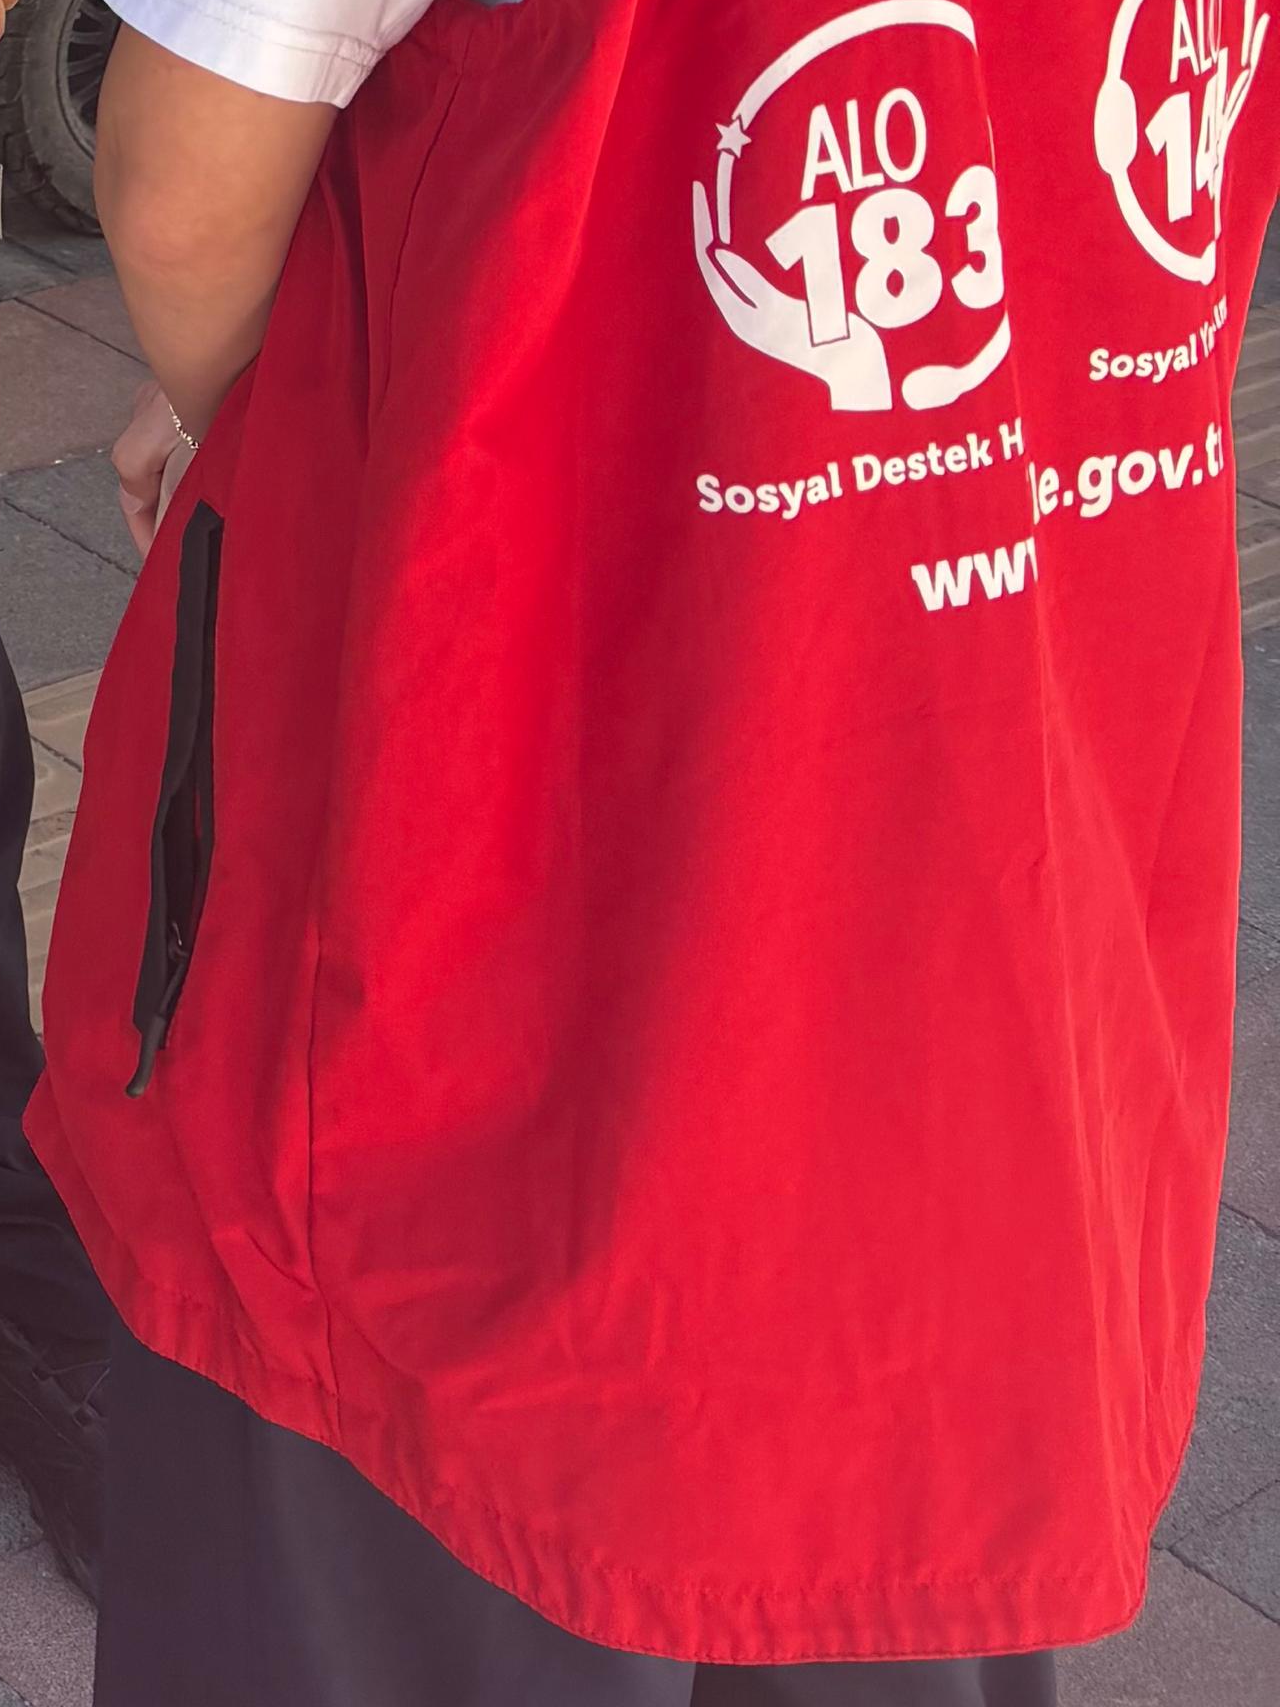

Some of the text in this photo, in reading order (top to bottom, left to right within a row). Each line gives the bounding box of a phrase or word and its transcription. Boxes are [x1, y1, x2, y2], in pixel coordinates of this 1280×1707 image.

[800, 87, 928, 201] ALO
[766, 166, 1003, 347] 183
[1089, 333, 1198, 384] Sosyal
[697, 461, 842, 521] Sosyal
[853, 432, 993, 490] Destek
